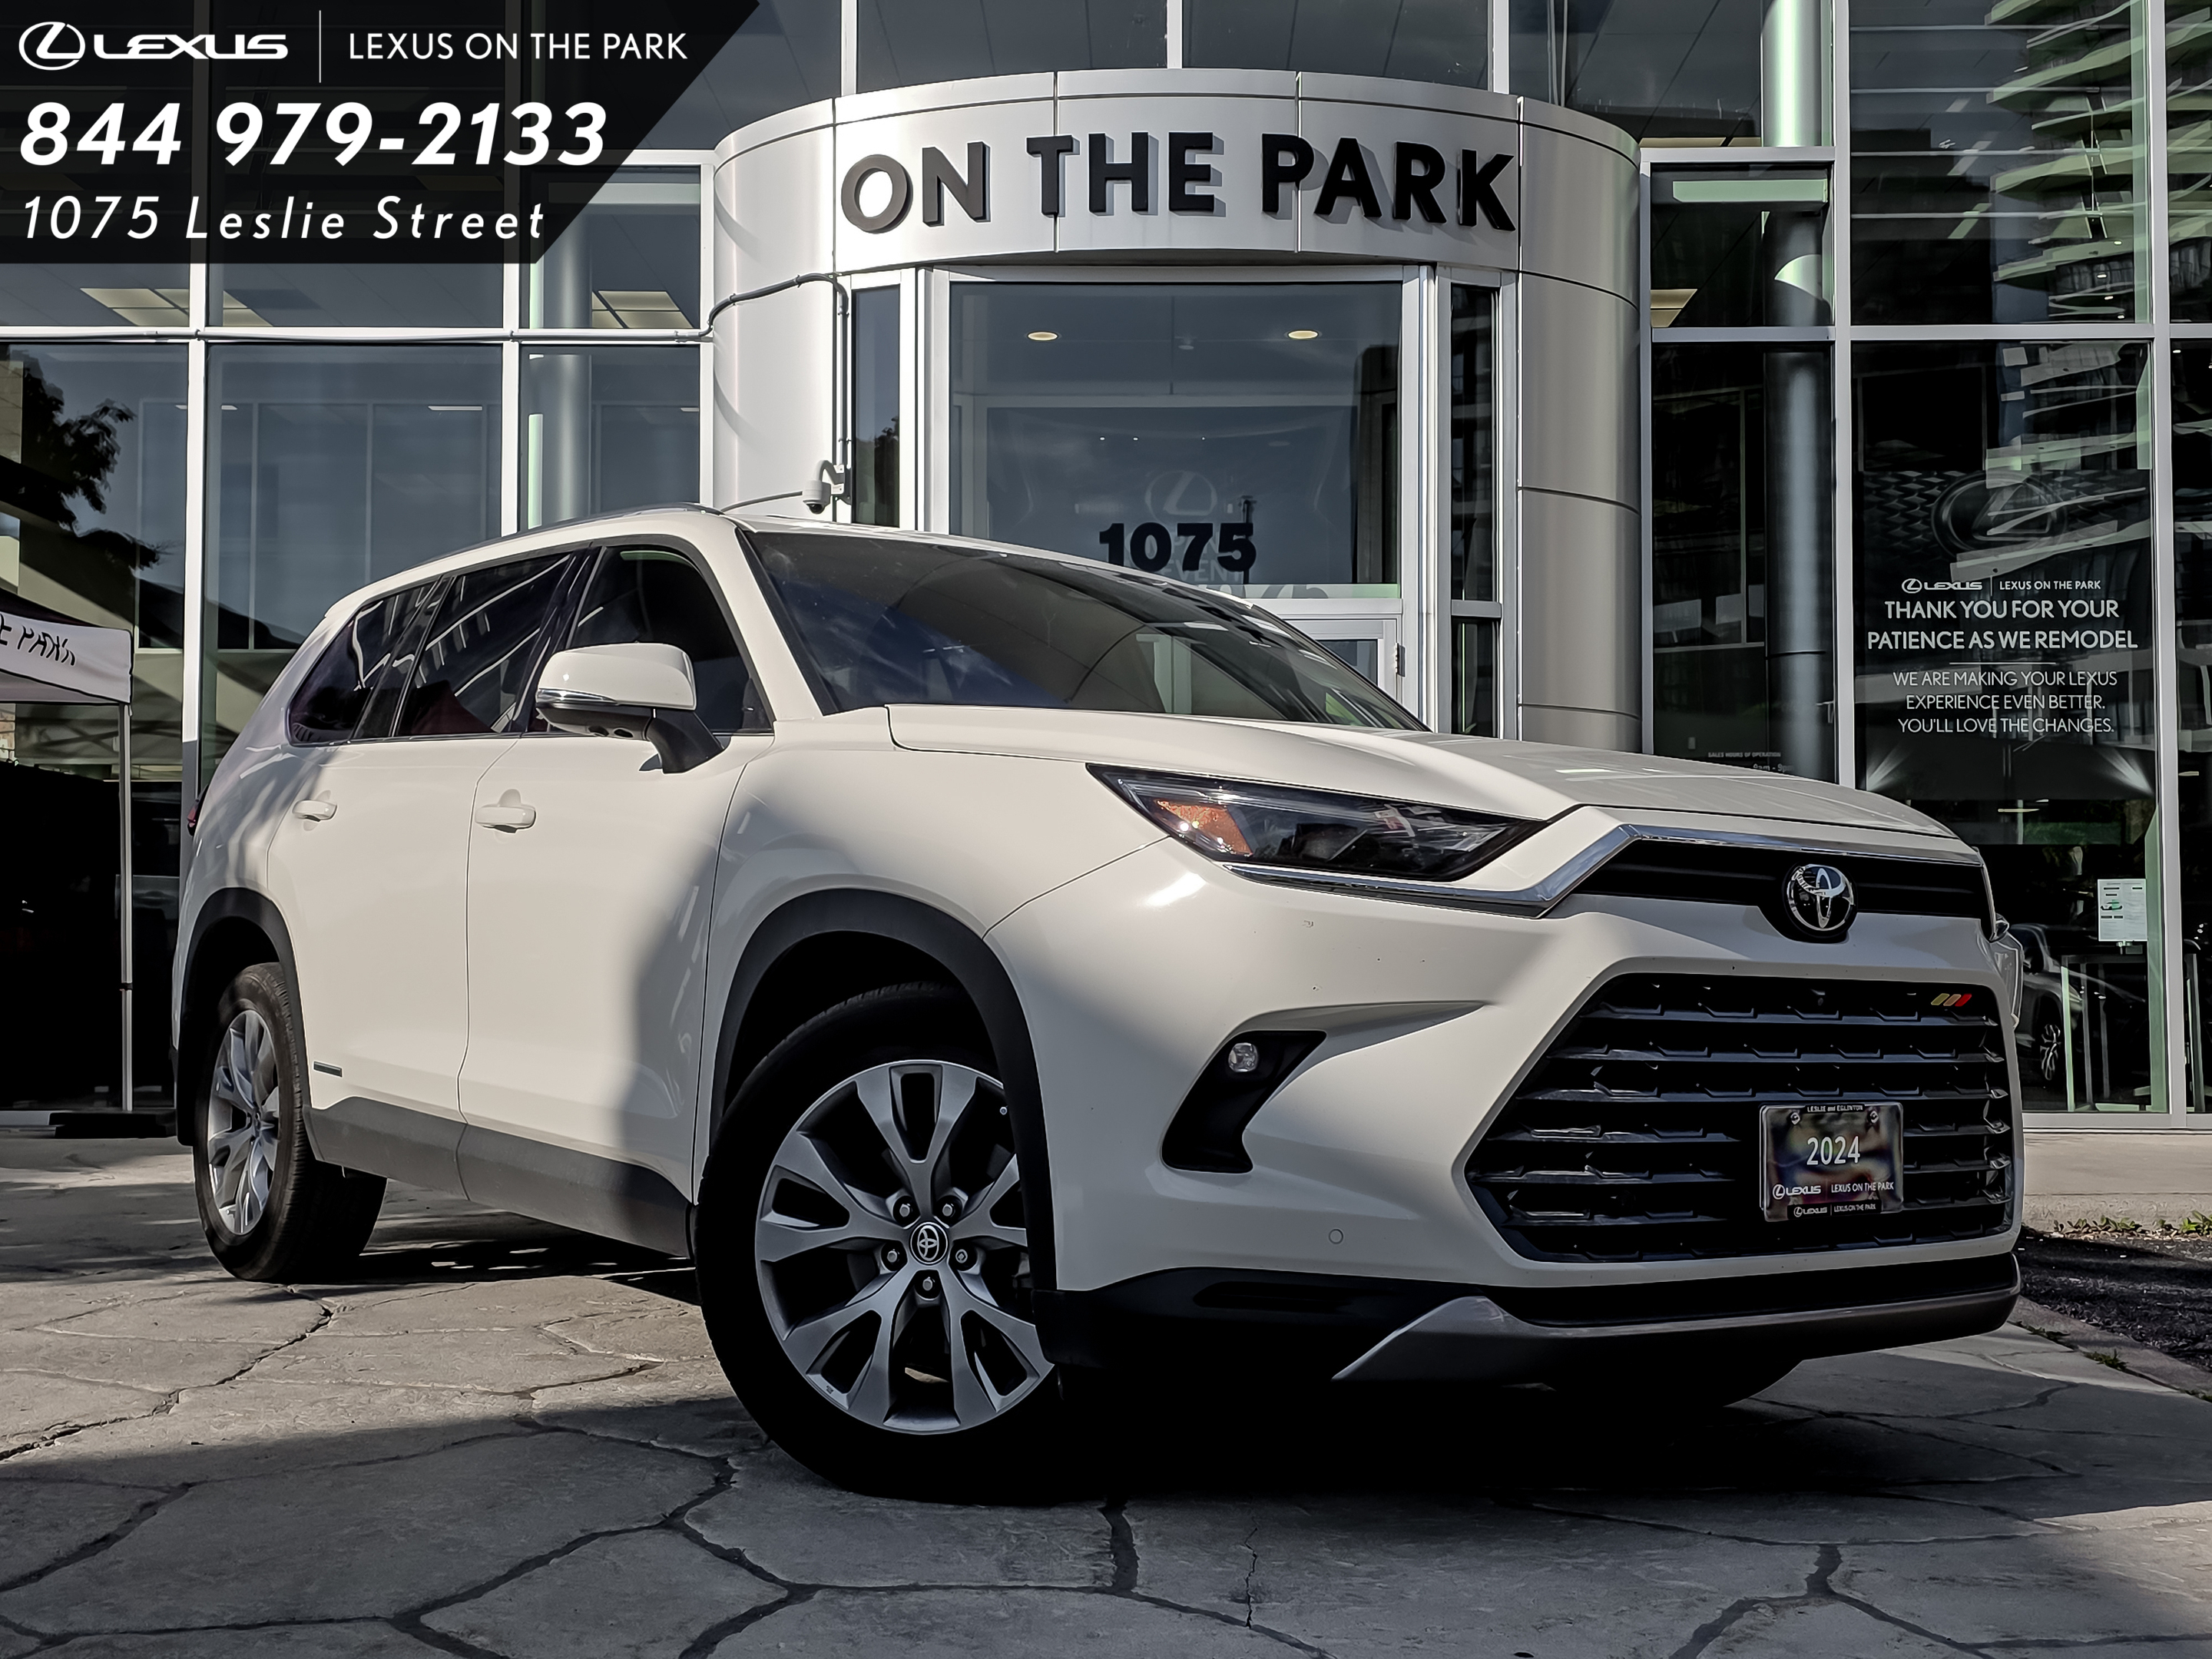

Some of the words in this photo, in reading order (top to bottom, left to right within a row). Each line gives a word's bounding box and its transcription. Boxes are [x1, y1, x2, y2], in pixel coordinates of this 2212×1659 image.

[841, 141, 991, 234] ON
[1026, 132, 1215, 217] THE
[1260, 133, 1516, 232] PARK
[1099, 522, 1257, 572] 1075
[1923, 581, 1983, 591] LEXUS
[1999, 581, 2032, 590] LEXUS
[2034, 581, 2051, 590] ON
[2053, 581, 2073, 590] THE
[2075, 580, 2101, 590] PARK
[1884, 601, 1957, 619] THANK
[1959, 600, 2007, 618] YOU
[2012, 600, 2055, 618] FOR
[2057, 599, 2120, 618] YOUR
[1868, 631, 1965, 650] PATIENCE
[1968, 631, 1995, 649] AS
[1998, 631, 2031, 649] WE
[2035, 630, 2138, 649] REMODEL
[1892, 671, 1919, 686] WE
[1921, 671, 1951, 686] ARE
[1954, 671, 2018, 686] MAKING
[2020, 671, 2065, 686] YOUR
[2069, 671, 2118, 686] LEXUS
[1906, 694, 2000, 710] EXPERIENCE
[2004, 694, 2045, 710] EVEN
[2048, 694, 2105, 710] BETTER.
[1898, 718, 1953, 733] YOU'LL
[1956, 718, 1997, 733] LOVE
[2000, 718, 2029, 733] THE
[2032, 718, 2114, 733] CHANGES.
[1806, 1135, 1861, 1166] 2024
[1785, 1185, 1822, 1196] LEXUS
[1831, 1183, 1851, 1194] LEXUS
[1853, 1183, 1863, 1191] ON
[1865, 1182, 1876, 1190] THE
[1877, 1181, 1895, 1190] PARK
